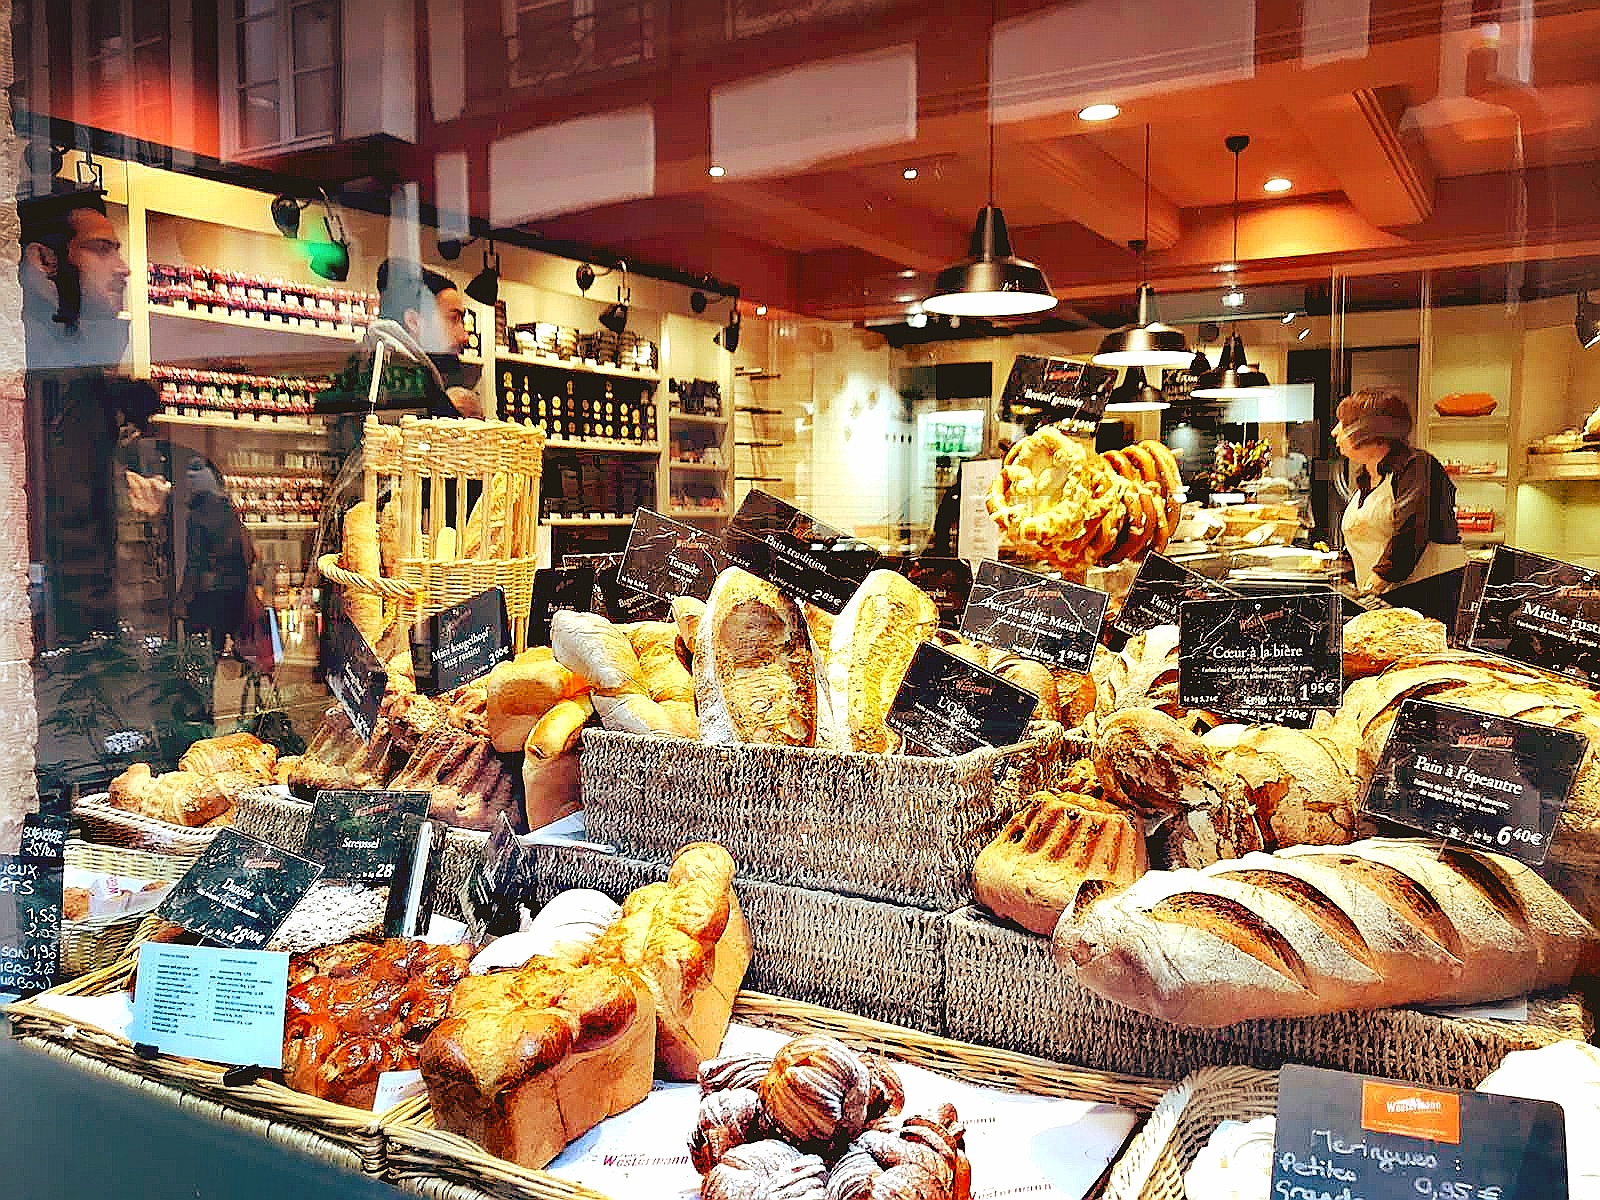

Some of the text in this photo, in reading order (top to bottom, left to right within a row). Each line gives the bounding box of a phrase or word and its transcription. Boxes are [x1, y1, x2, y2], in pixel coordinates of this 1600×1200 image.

[1522, 602, 1567, 625] Miche
[1212, 646, 1247, 659] Cœur
[1260, 643, 1270, 658] la
[1274, 643, 1304, 658] bière
[1413, 754, 1443, 775] Pain
[1444, 763, 1454, 777] à
[375, 863, 395, 878] 28
